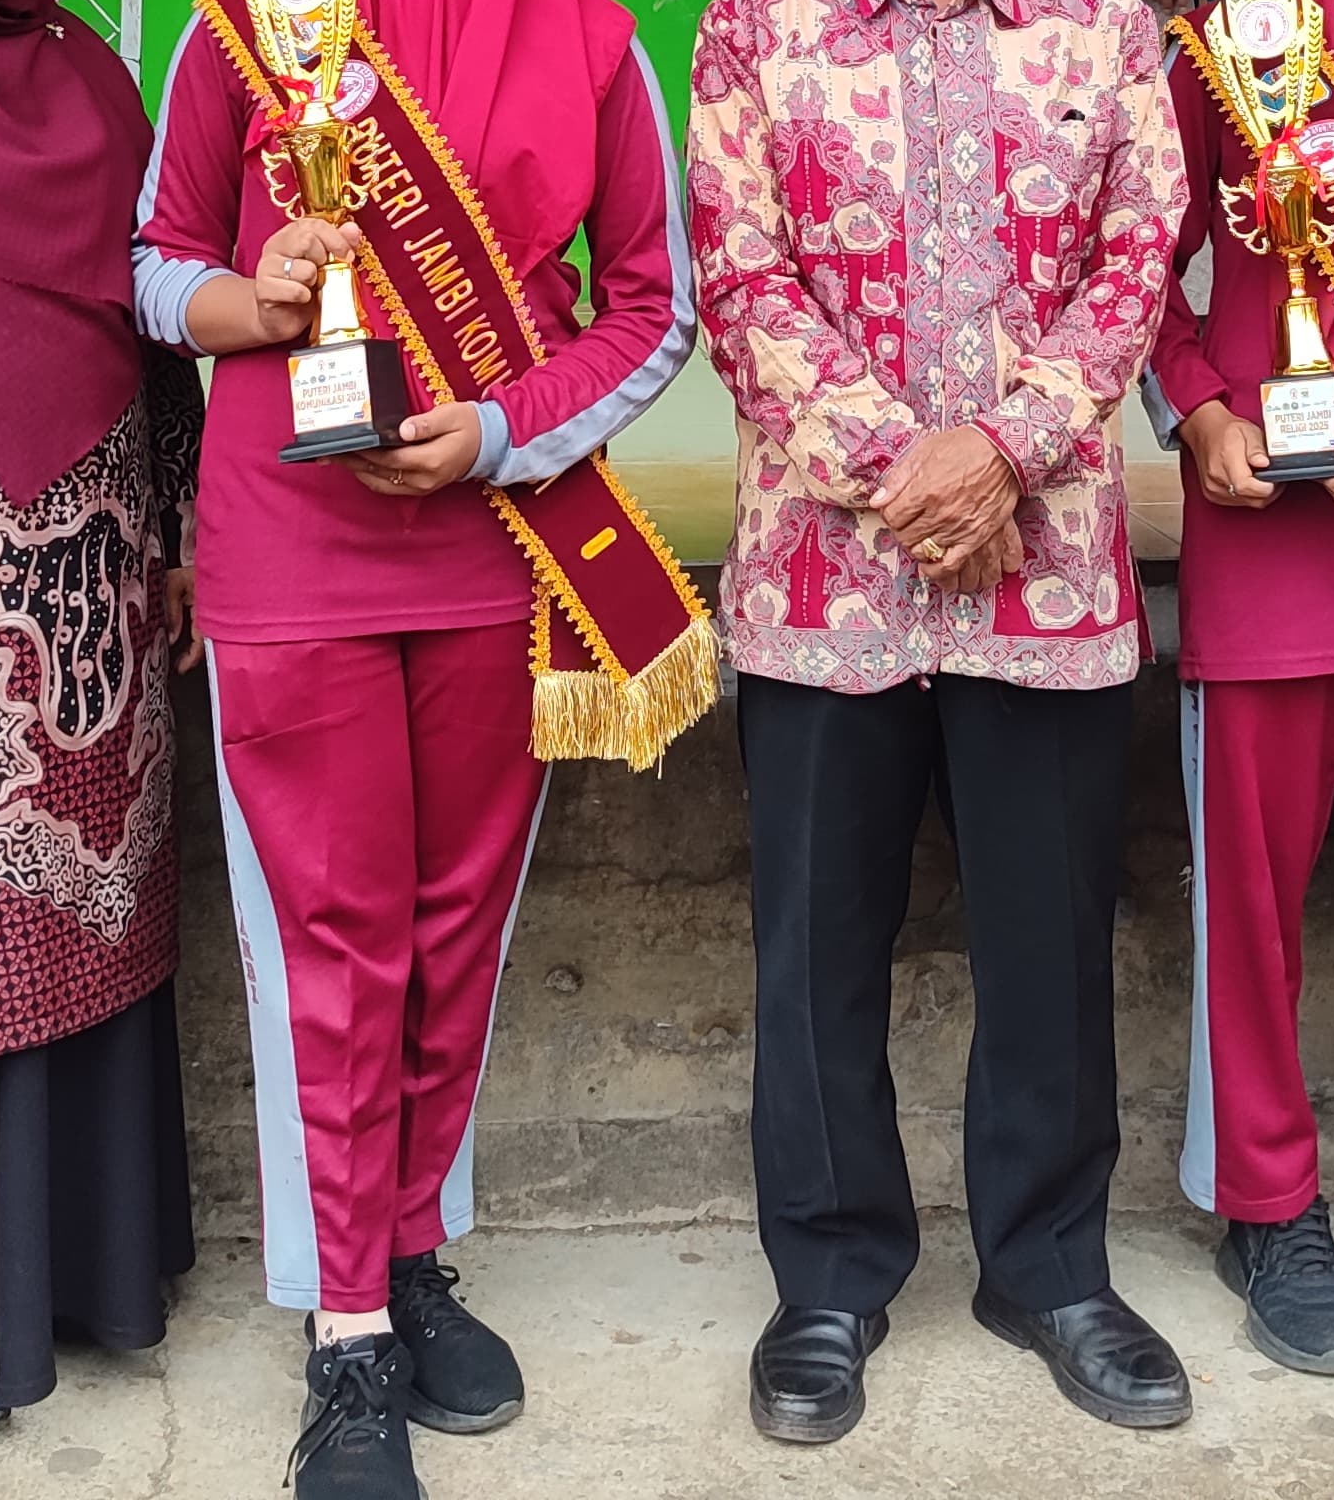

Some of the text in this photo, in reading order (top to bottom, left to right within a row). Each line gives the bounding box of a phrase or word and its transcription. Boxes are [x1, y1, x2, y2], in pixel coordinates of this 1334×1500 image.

[403, 227, 480, 323] JAMBI
[302, 385, 331, 398] PUTERI
[333, 381, 357, 393] JAMBI
[1274, 412, 1305, 424] PUTERI
[1308, 420, 1329, 432] 2025
